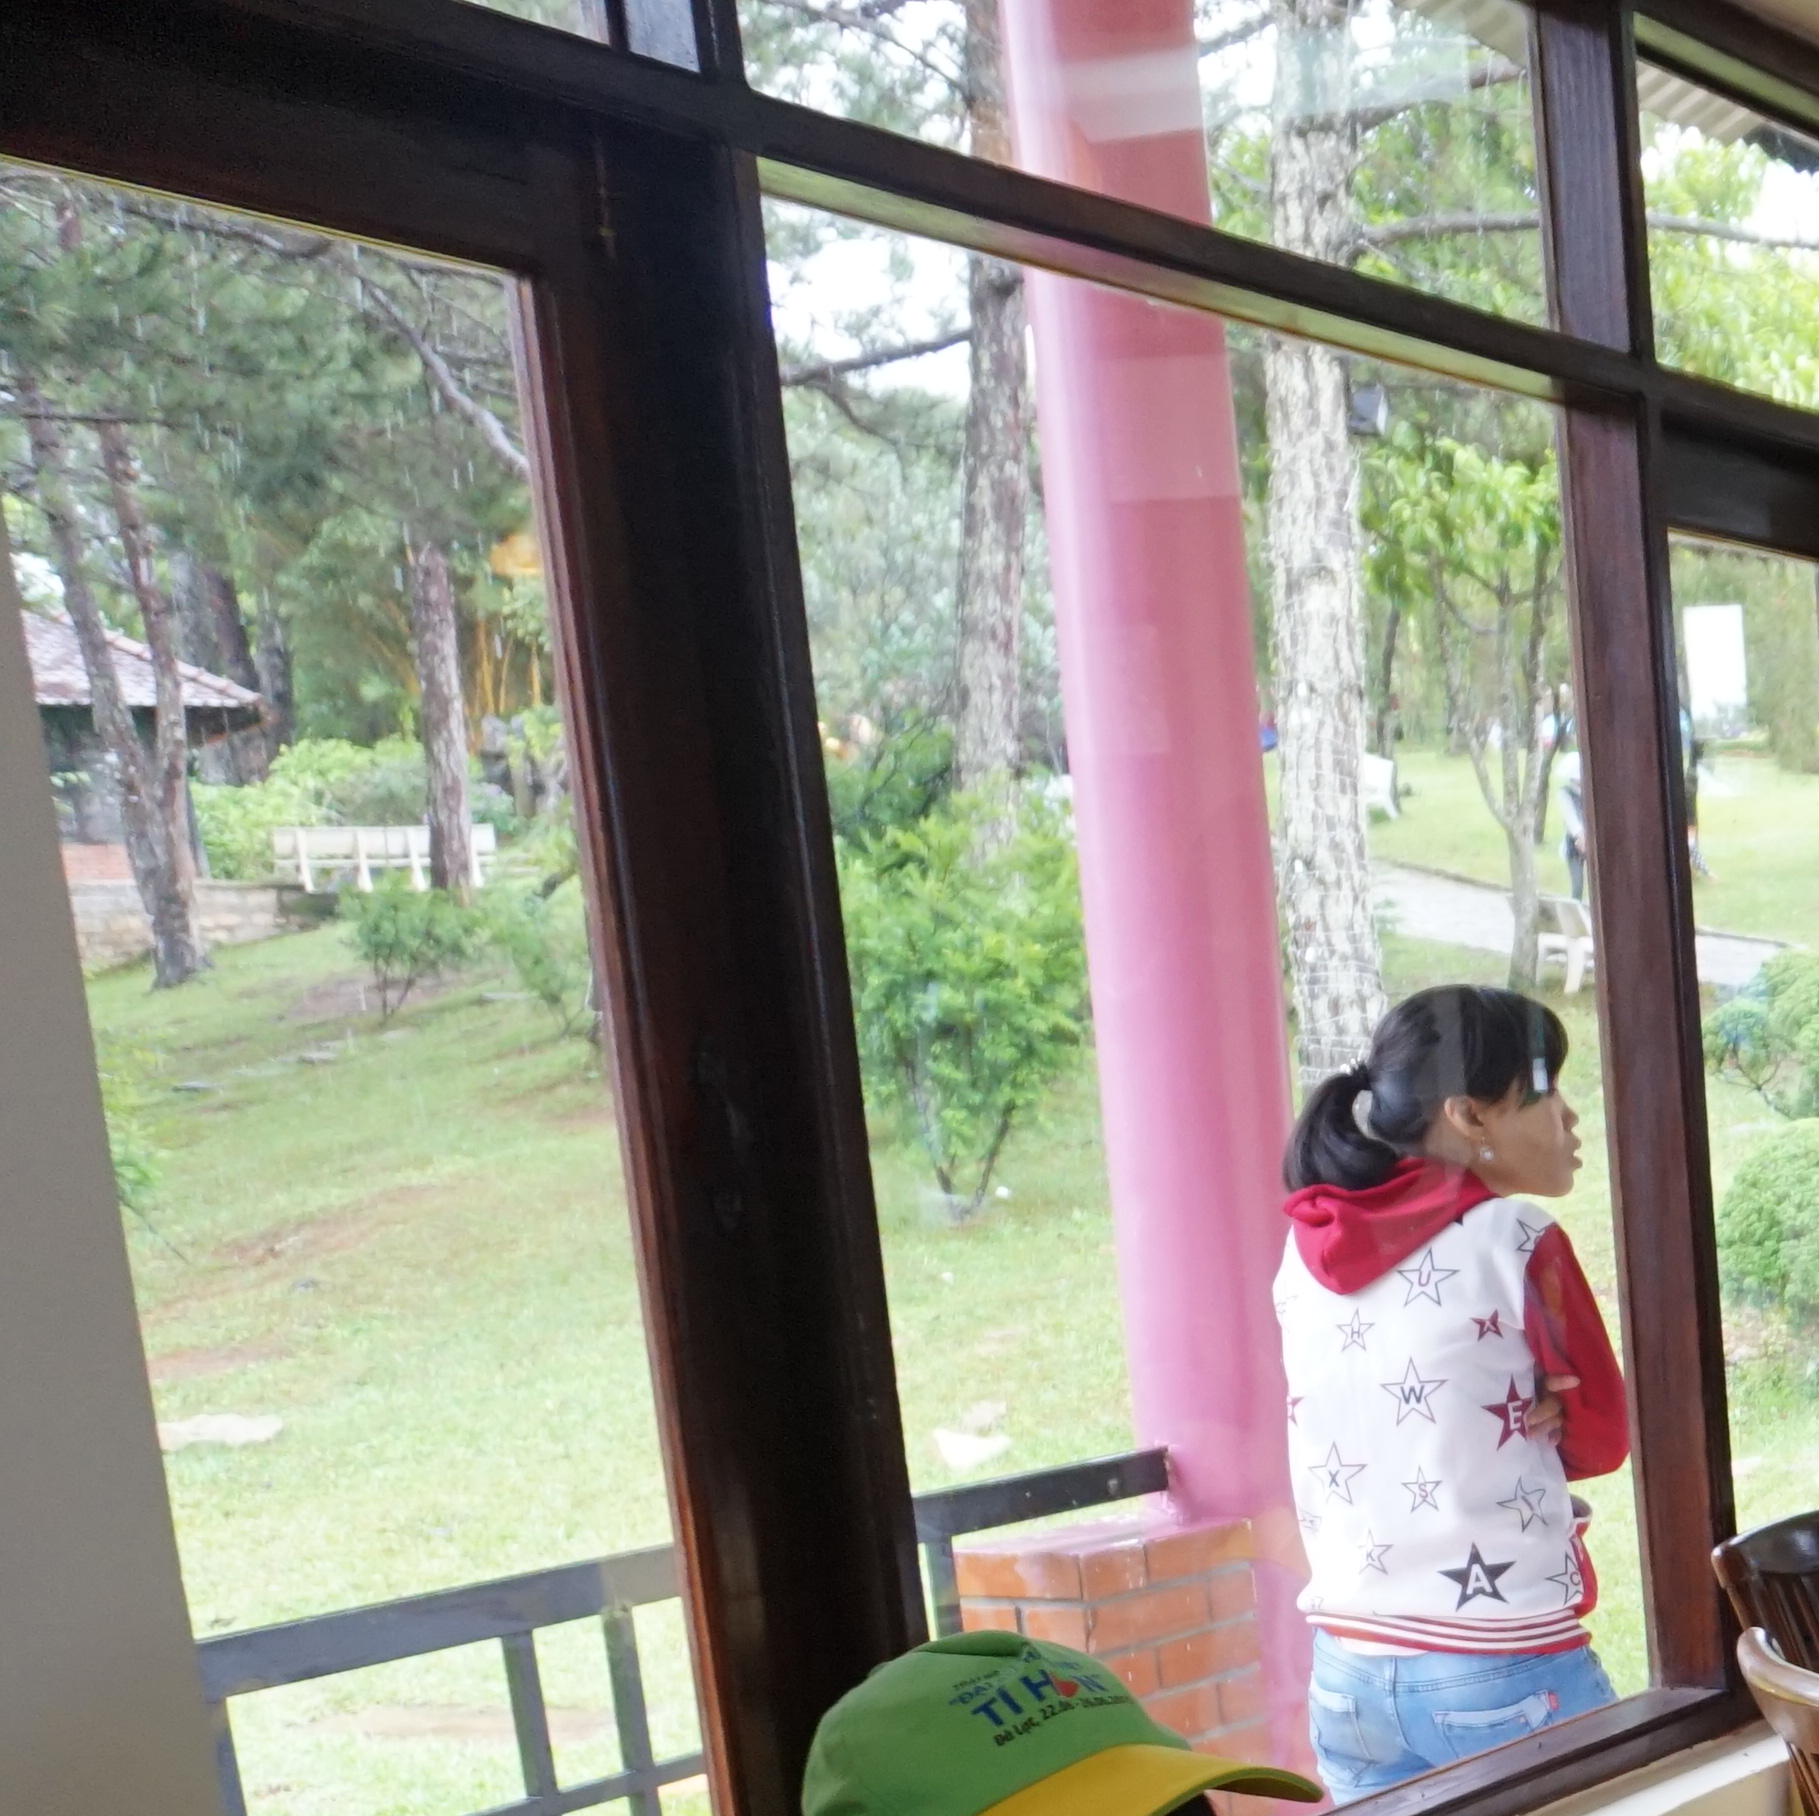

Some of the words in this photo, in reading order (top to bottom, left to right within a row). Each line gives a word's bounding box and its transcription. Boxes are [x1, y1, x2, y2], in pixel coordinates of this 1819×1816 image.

[1418, 1270, 1432, 1287] U
[1400, 1385, 1425, 1405] W
[1508, 1402, 1523, 1430] E
[1466, 1563, 1493, 1595] A
